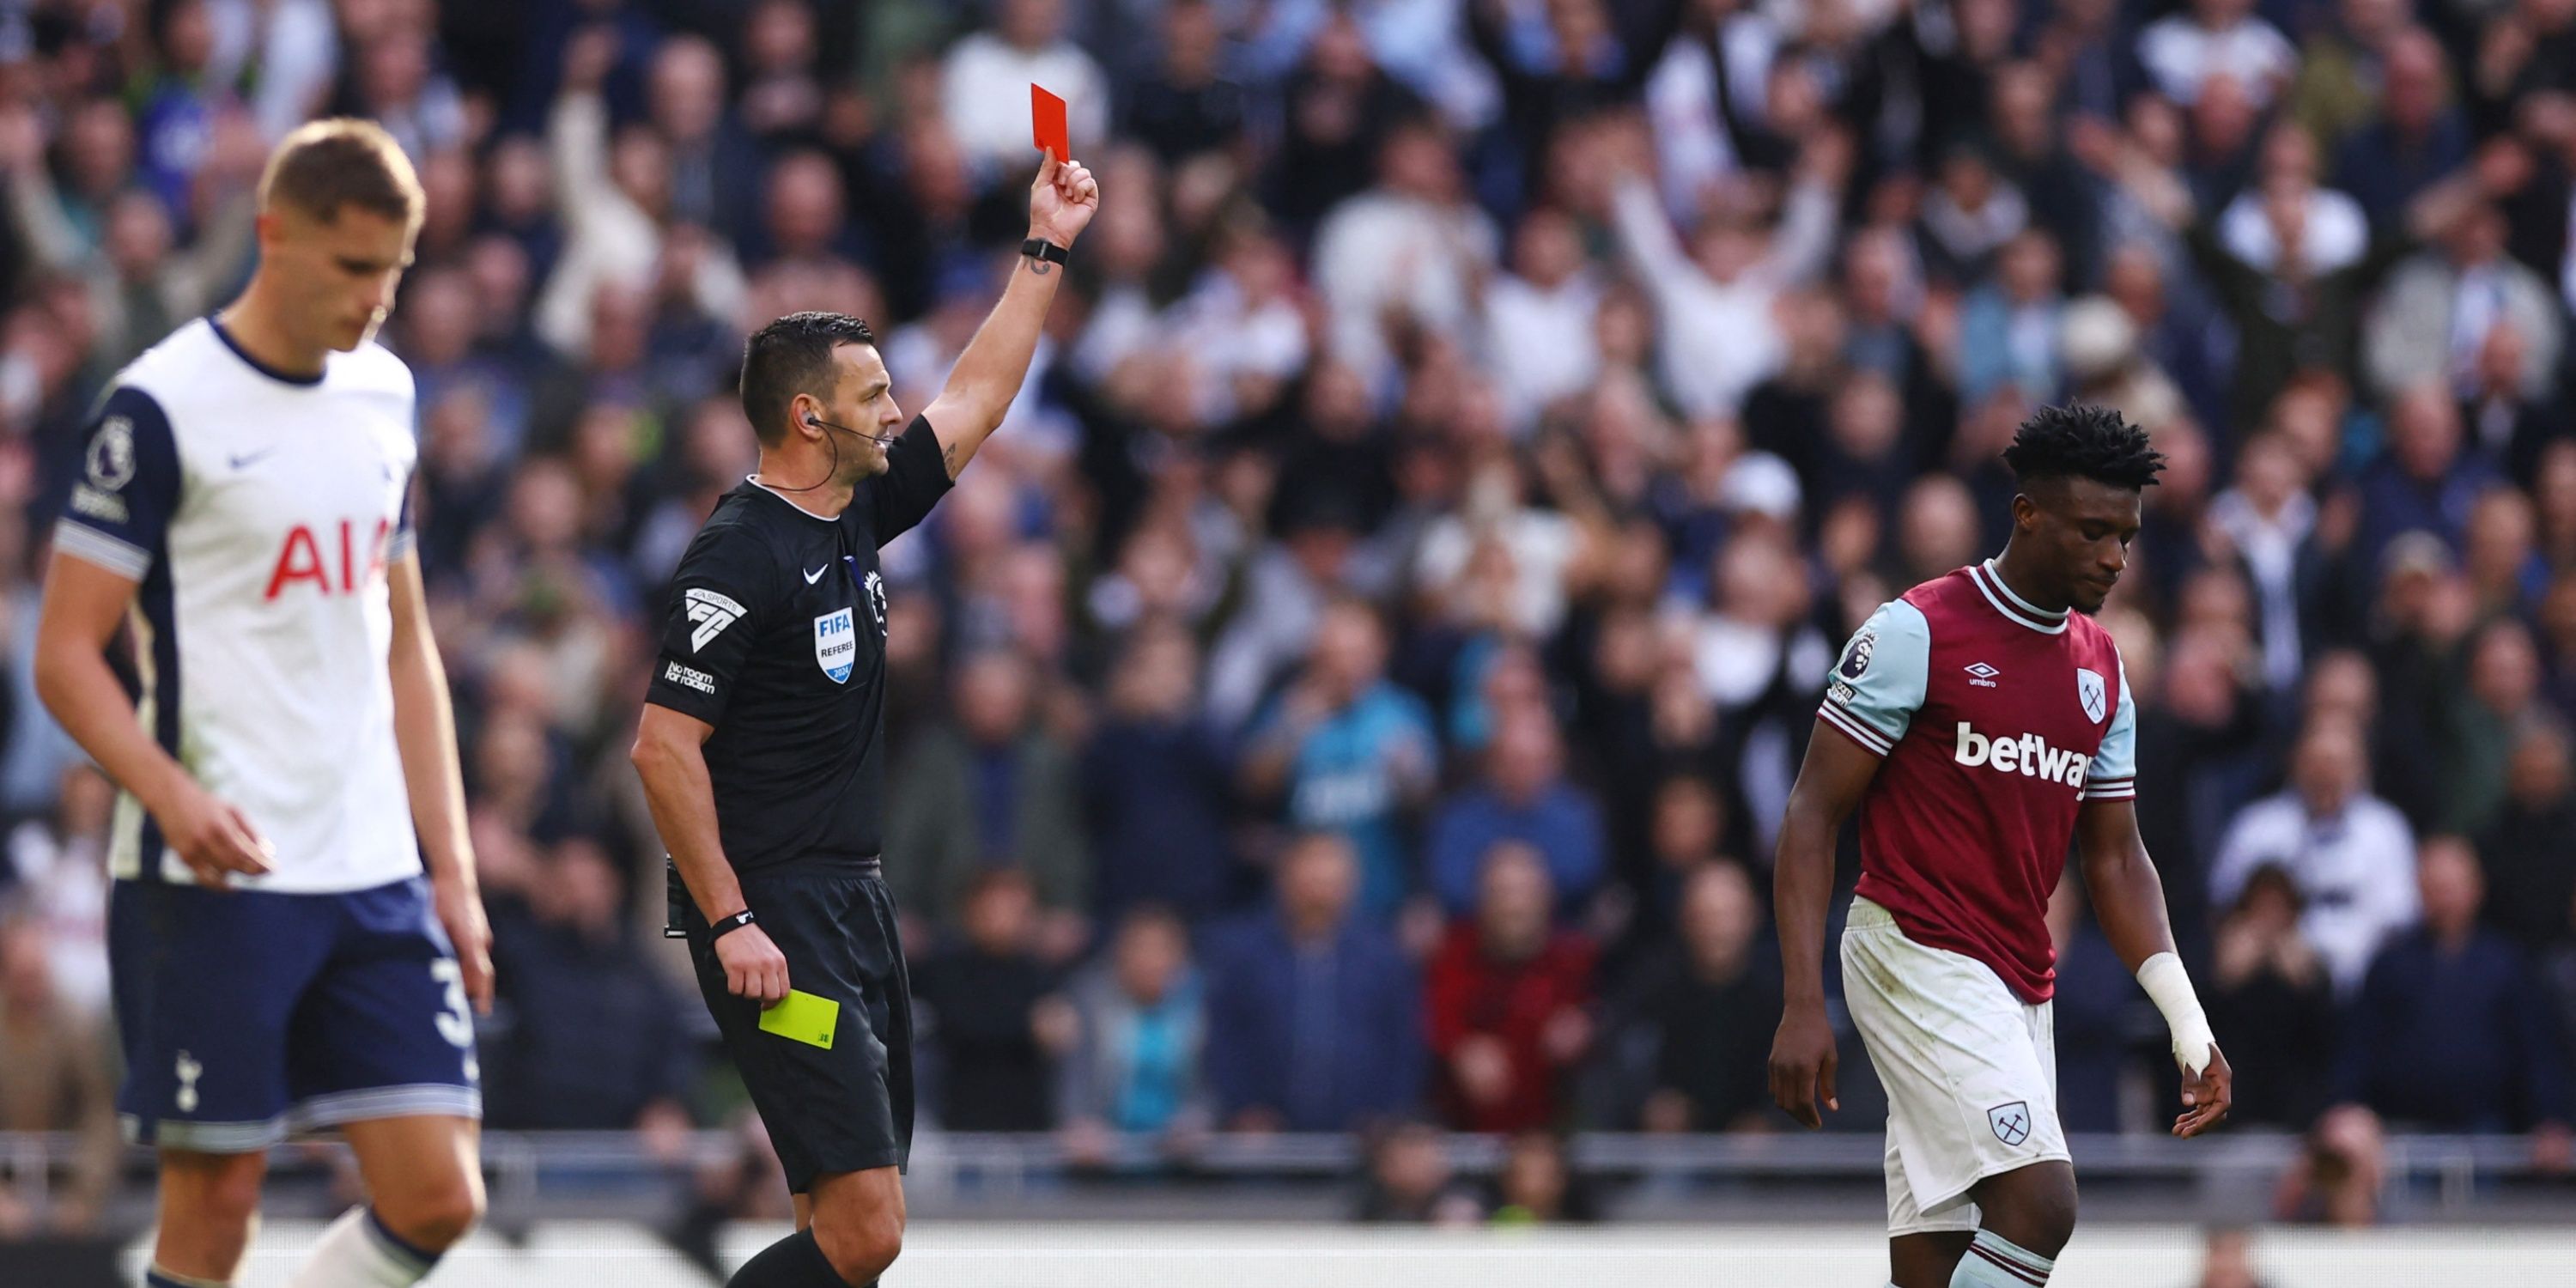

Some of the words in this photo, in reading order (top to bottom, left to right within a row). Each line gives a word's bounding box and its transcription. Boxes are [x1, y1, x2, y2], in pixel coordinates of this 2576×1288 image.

[706, 592, 738, 612] SPORTS
[819, 613, 851, 637] FIFA
[821, 641, 854, 658] REFEREE
[665, 669, 681, 683] for
[667, 660, 683, 674] No
[683, 666, 714, 684] room
[834, 668, 849, 678] 2024
[1969, 677, 1996, 688] umbro
